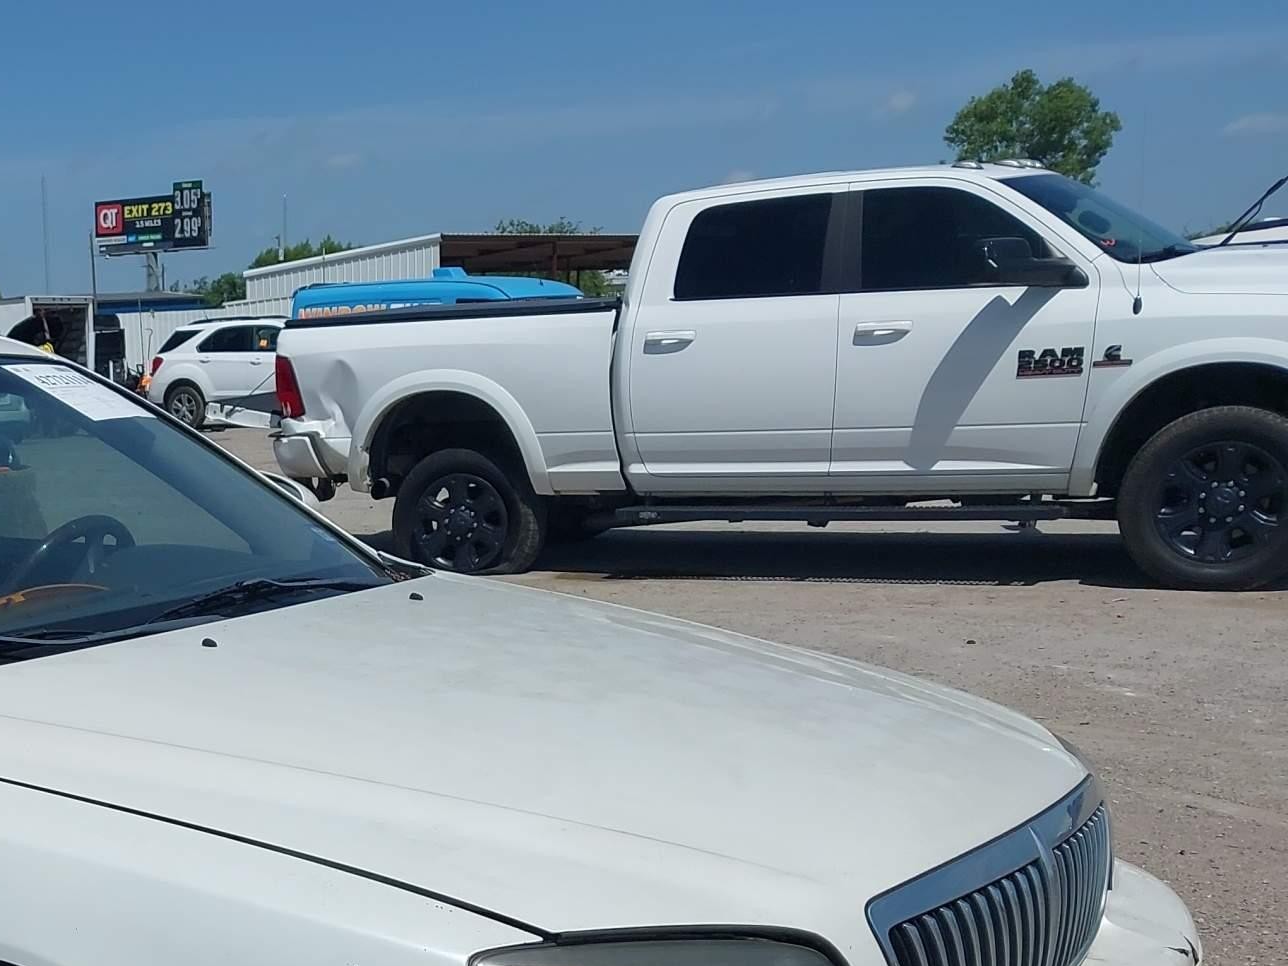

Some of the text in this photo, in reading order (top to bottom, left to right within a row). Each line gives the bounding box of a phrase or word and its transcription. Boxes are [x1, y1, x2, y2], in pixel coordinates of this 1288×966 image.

[124, 202, 173, 218] EXIT 273
[100, 209, 118, 229] QT
[1018, 347, 1084, 360] RAM
